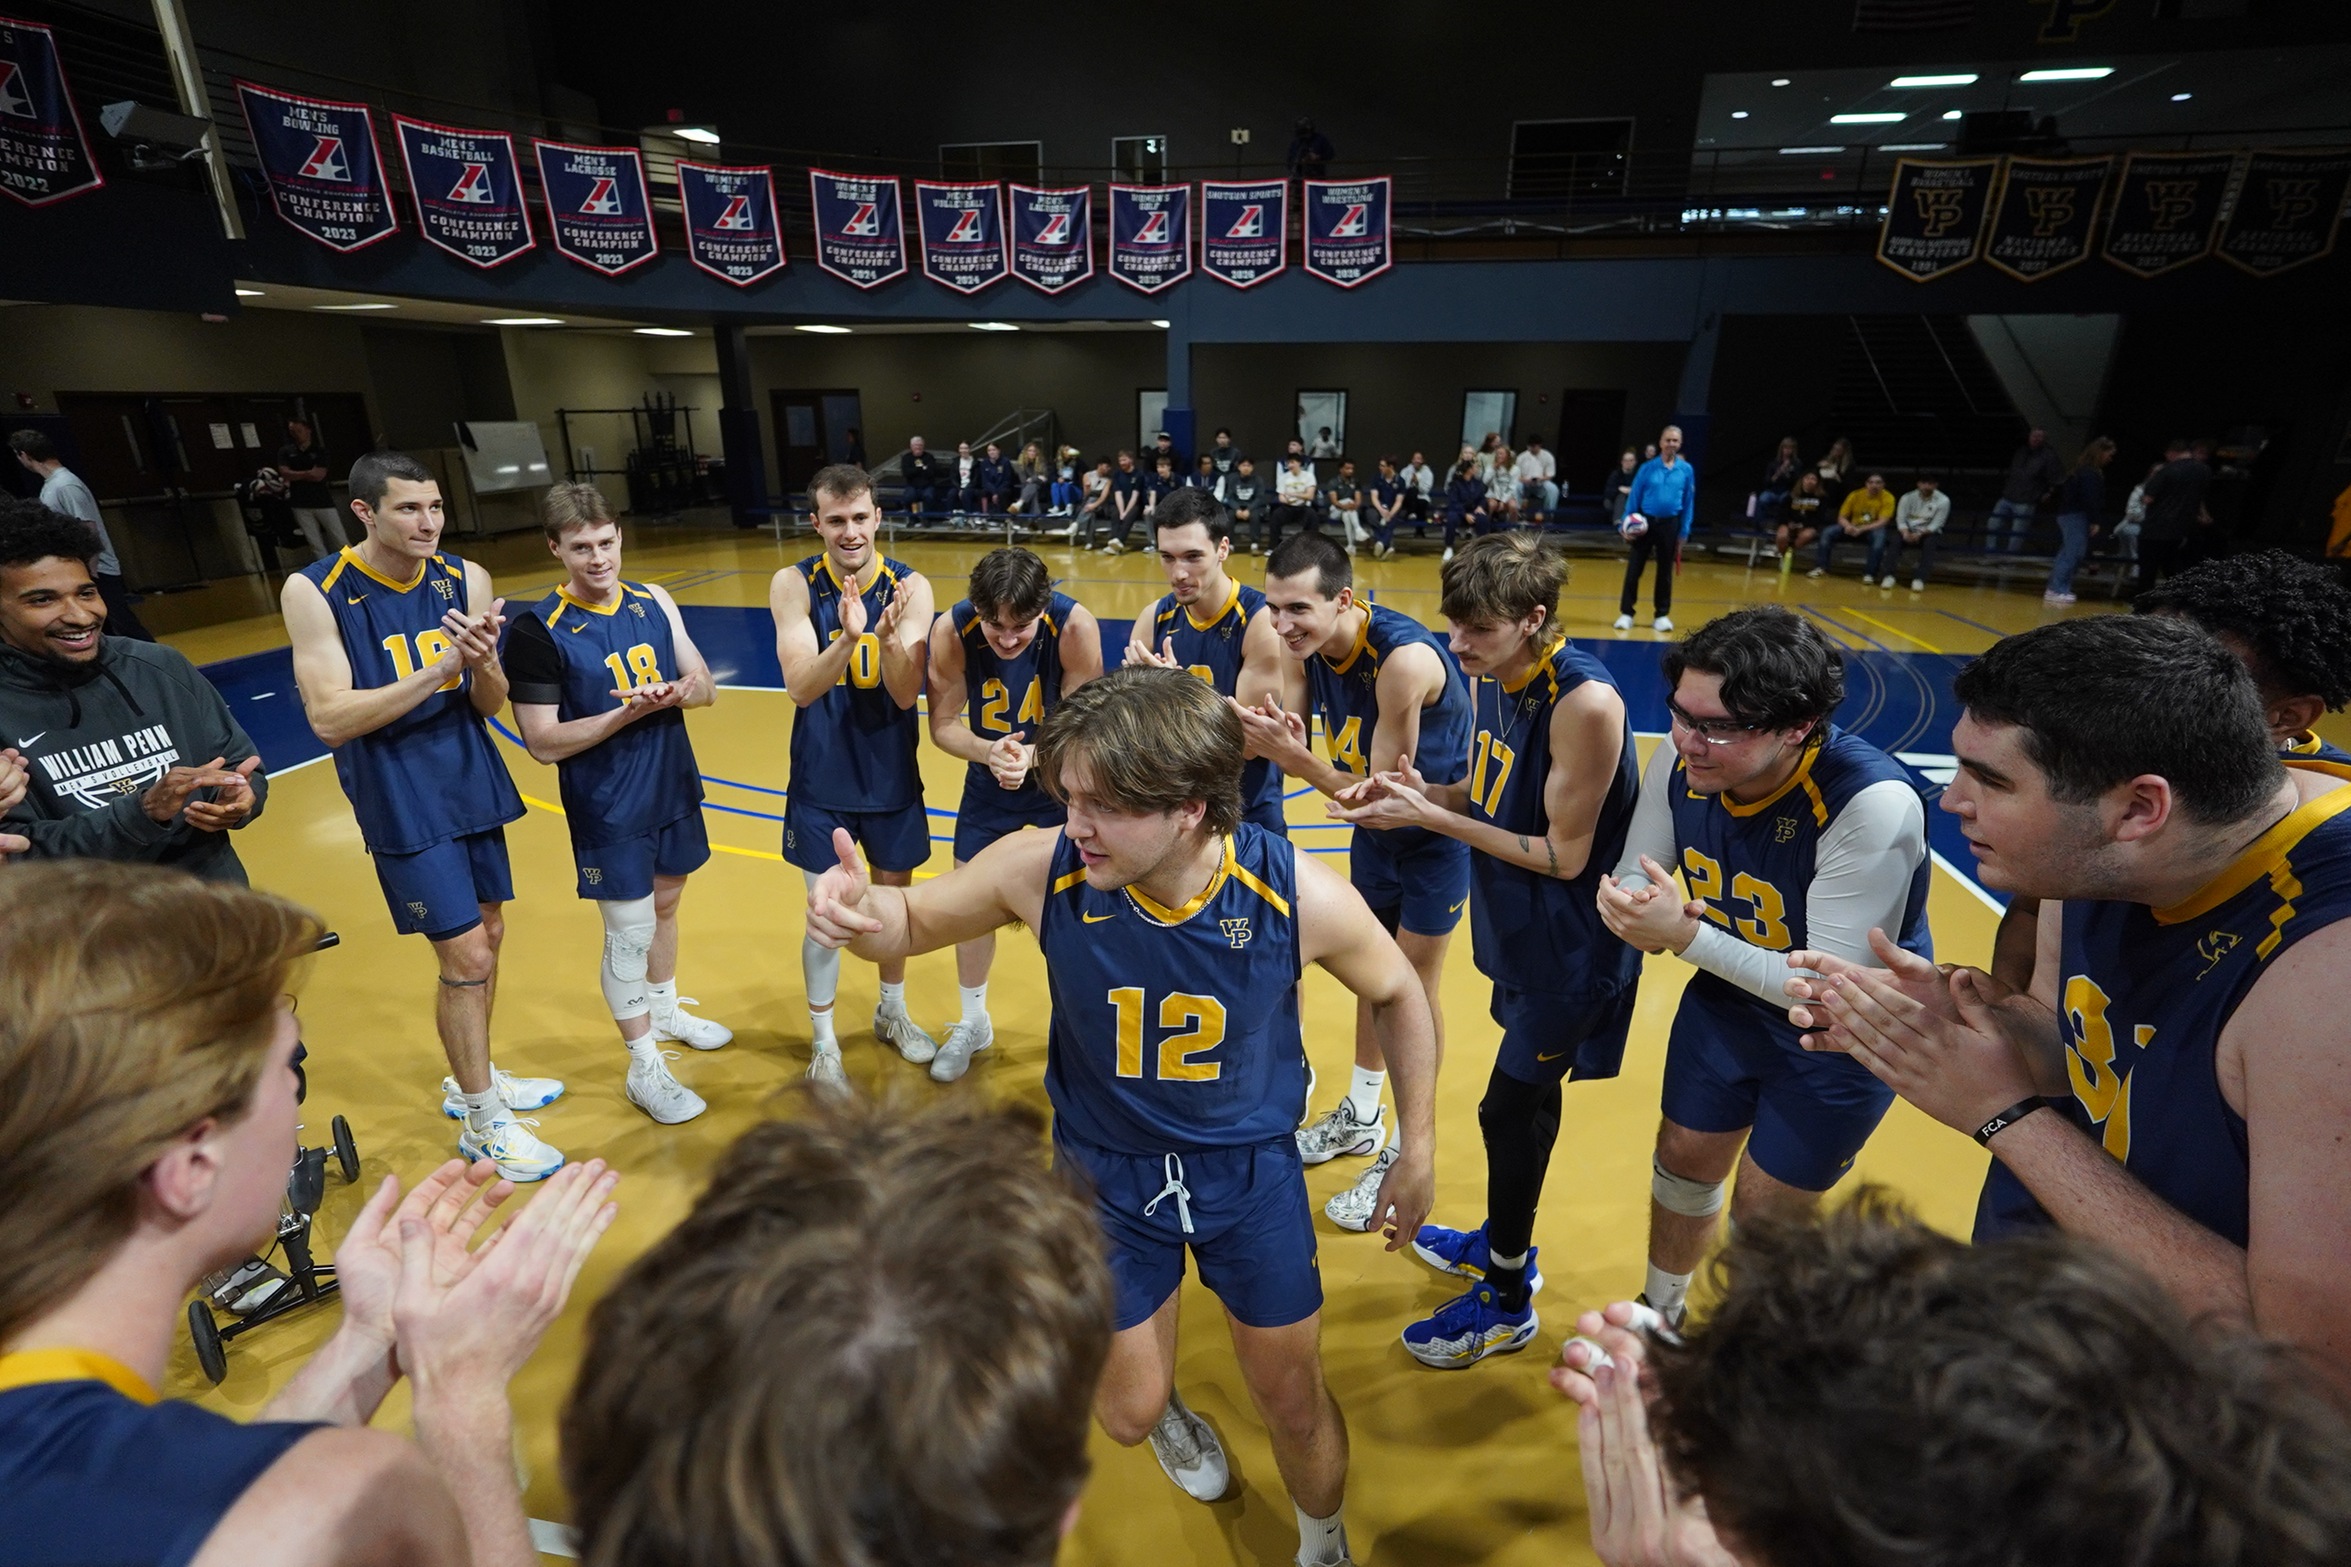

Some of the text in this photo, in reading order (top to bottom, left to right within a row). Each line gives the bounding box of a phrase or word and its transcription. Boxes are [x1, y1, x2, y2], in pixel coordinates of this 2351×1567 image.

[289, 106, 328, 123] MEN'S
[282, 116, 340, 135] BOWLING
[0, 138, 76, 161] ERENCE
[440, 137, 475, 151] MEN'S
[421, 143, 494, 162] BASKETBALL
[0, 153, 69, 173] MPION
[574, 154, 606, 166] MEN'S
[564, 163, 617, 176] LACROSSE
[1, 170, 50, 193] 2022
[280, 191, 380, 213] CONFERENCE
[293, 205, 374, 223] CHAMPION
[430, 214, 519, 231] CONFERENCE
[321, 226, 357, 240] 2023
[441, 226, 513, 241] CHAMPION
[563, 227, 645, 240] CONFERENCE
[466, 244, 498, 257] 2023
[574, 238, 639, 249] CHAMPION
[698, 241, 773, 254] CONFERENCE
[595, 253, 624, 265] 2023
[708, 251, 767, 262] CHAMPION
[826, 245, 897, 259] CONFERENCE
[931, 254, 999, 264] CONFERENCE
[1117, 253, 1183, 264] CONFERENCE
[1209, 248, 1278, 259] CONFERENCE
[1312, 246, 1383, 258] CONFERENCE
[834, 256, 891, 266] CHAMPION
[1018, 253, 1084, 266] CONFERENCE
[1215, 257, 1271, 267] CHAMPION
[1320, 255, 1377, 266] CHAMPION
[938, 262, 994, 272] CHAMPION
[1025, 263, 1078, 273] CHAMPION
[1123, 262, 1177, 272] CHAMPION
[604, 643, 664, 706] 18
[982, 673, 1045, 733] 24
[38, 724, 173, 781] WILLIAM PENN
[59, 752, 176, 793] MEN'S VOLLEYBALL
[1470, 729, 1516, 818] 17
[1683, 846, 1794, 952] 23
[1107, 986, 1227, 1082] 12
[1981, 1118, 2008, 1137] FCA
